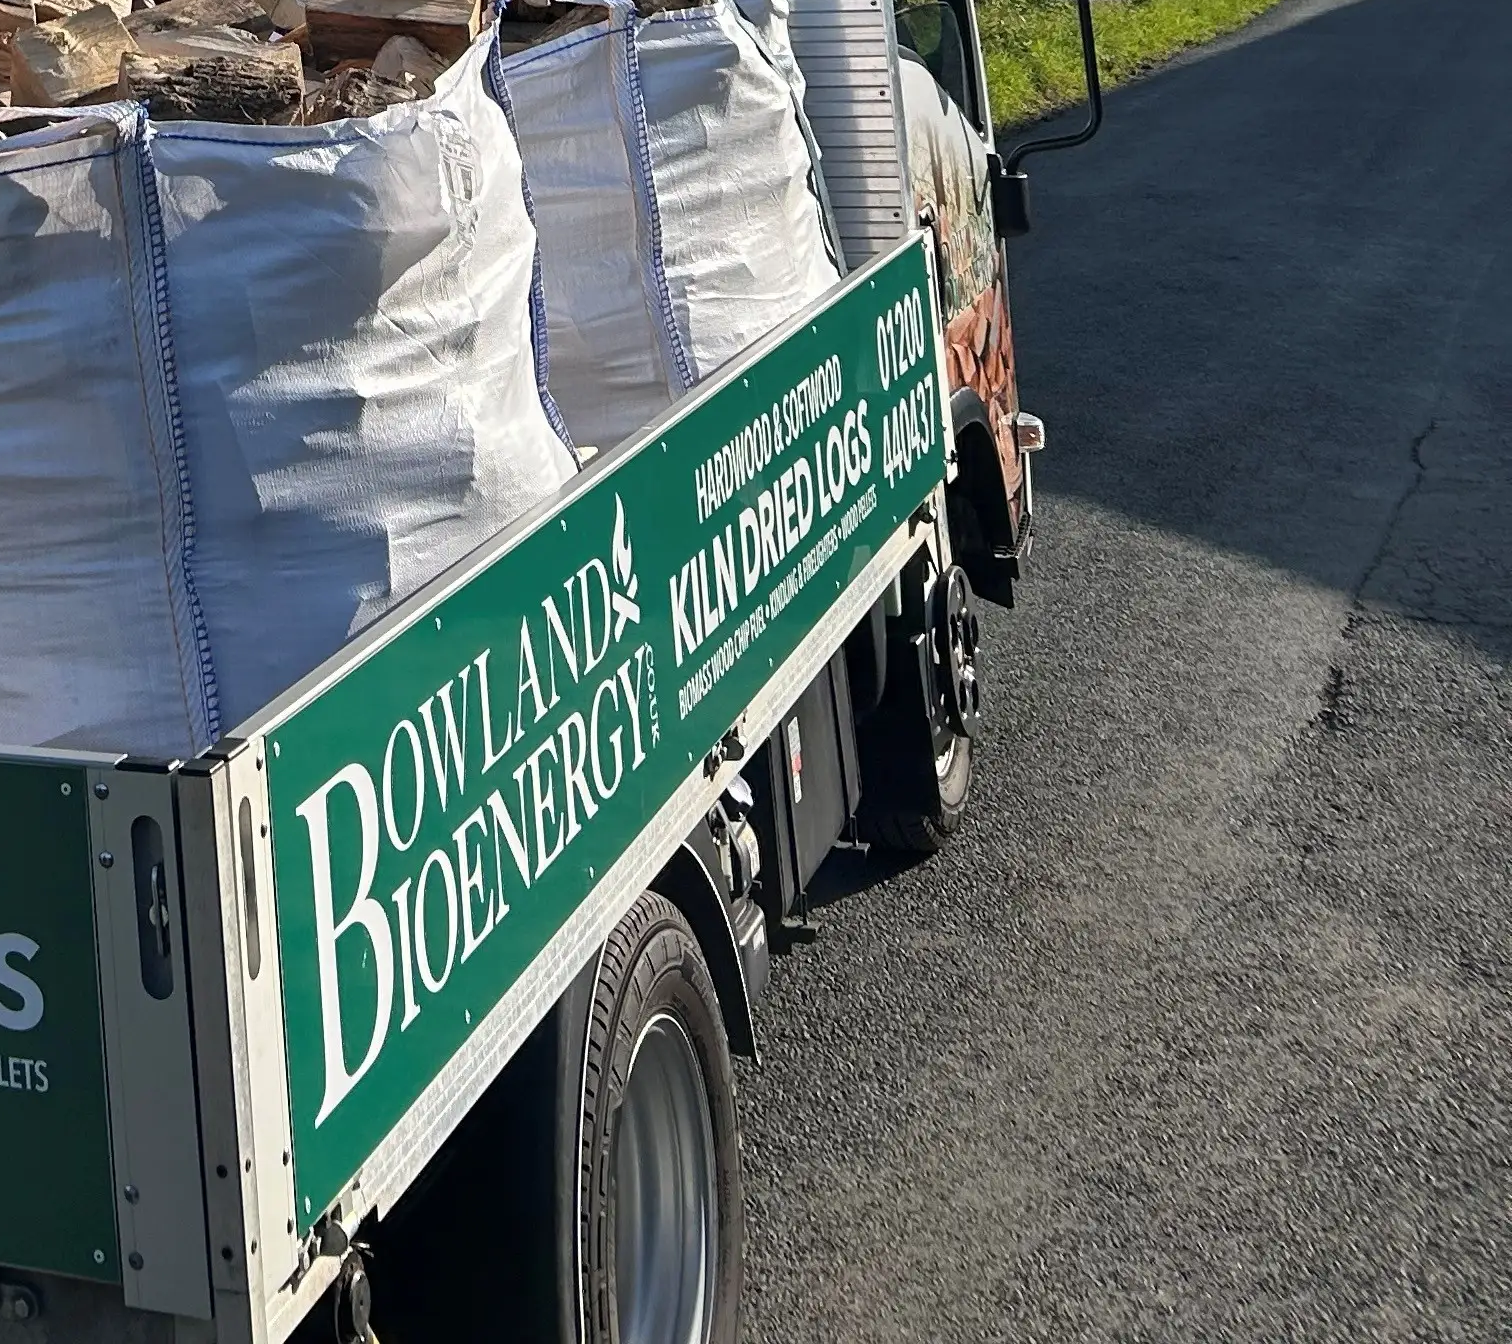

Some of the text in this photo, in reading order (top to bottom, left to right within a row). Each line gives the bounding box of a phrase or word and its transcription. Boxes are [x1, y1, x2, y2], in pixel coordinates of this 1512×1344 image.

[876, 286, 926, 393] 01200
[695, 354, 842, 525] HARDWOOD & SOFTWOOD
[883, 372, 936, 490] 440437
[669, 398, 872, 668] KILN DRIED LOGS
[678, 659, 713, 721] BIOMASS
[711, 637, 735, 684] WOOD
[734, 619, 750, 660] CHIP
[296, 558, 611, 1002] BOWLAND
[296, 644, 646, 1129] BIOENERGY
